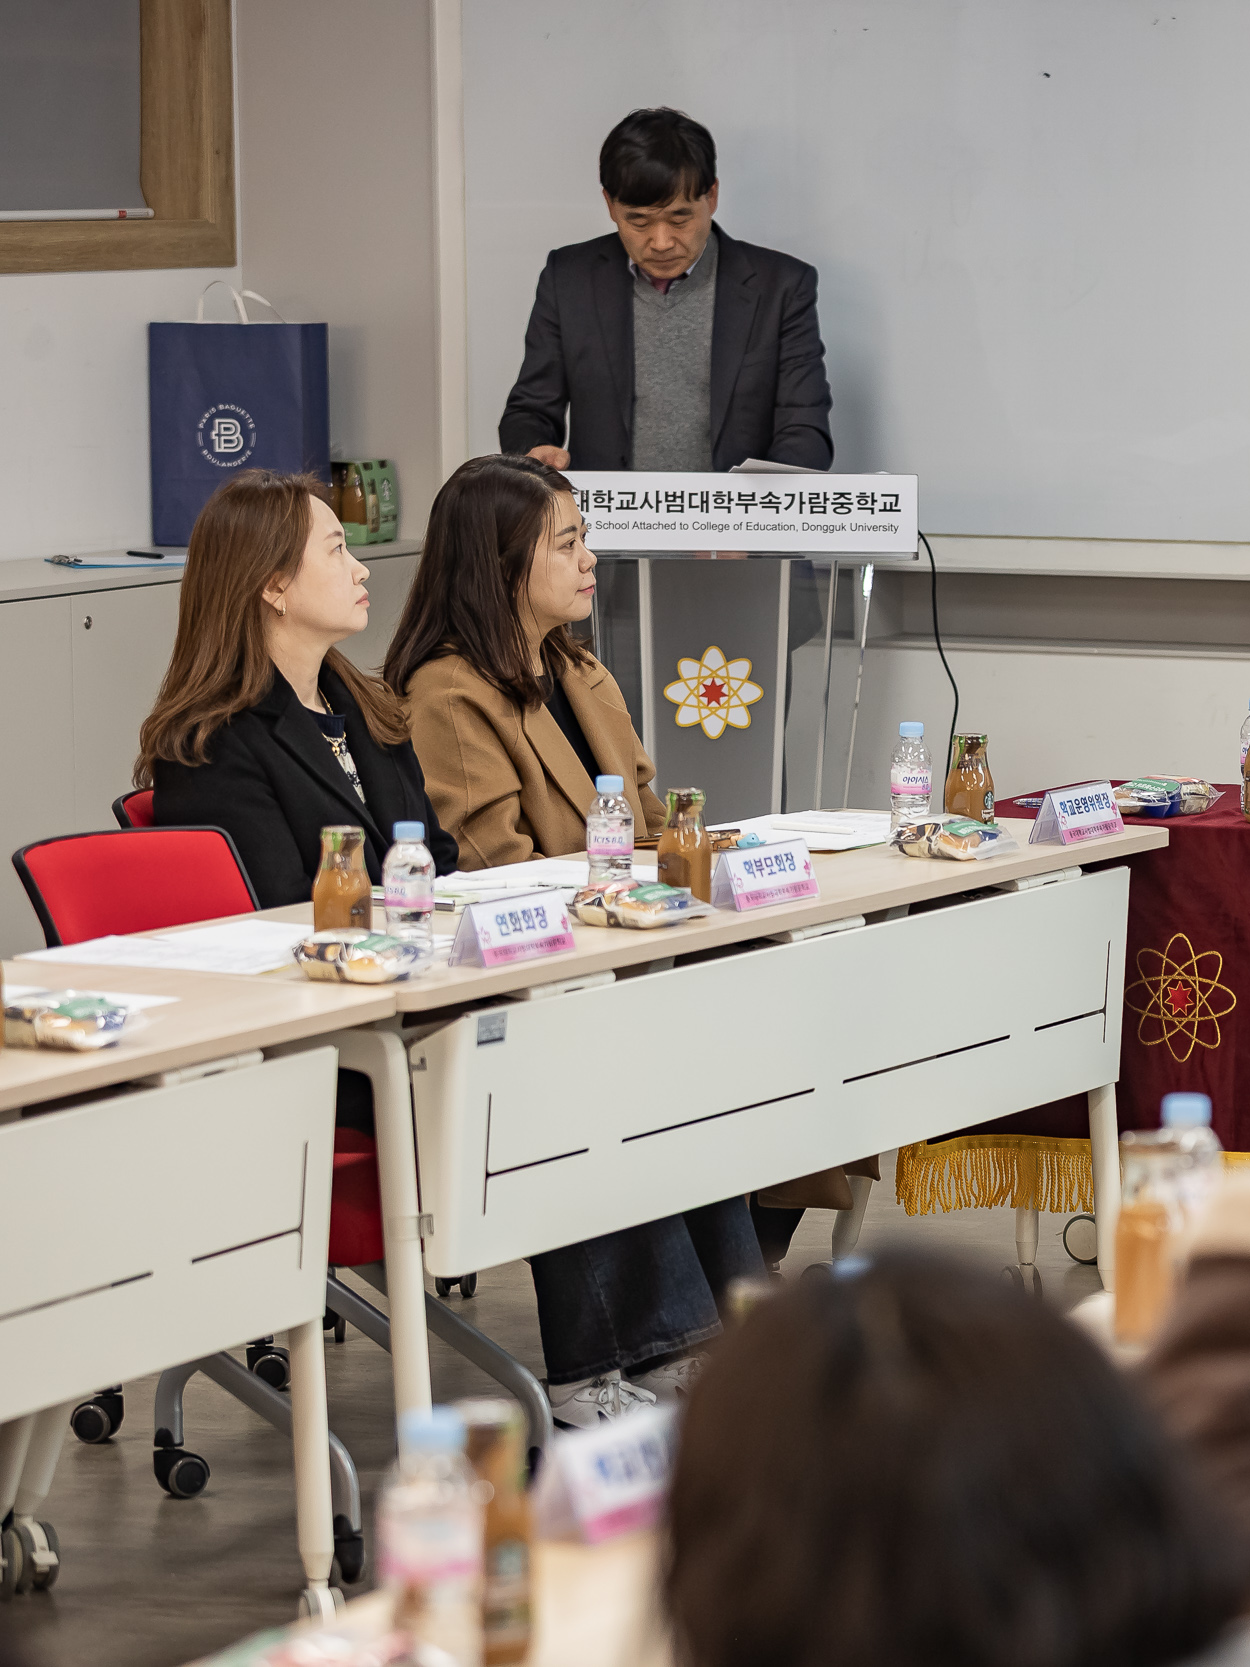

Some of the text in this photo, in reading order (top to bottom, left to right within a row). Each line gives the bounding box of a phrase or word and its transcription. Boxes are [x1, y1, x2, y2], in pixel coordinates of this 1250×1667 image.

[197, 404, 256, 430] PARIS BAGUETTE
[595, 520, 630, 531] School
[632, 521, 677, 531] Attached
[680, 522, 689, 531] to
[692, 521, 730, 534] College
[733, 522, 743, 532] of
[746, 522, 799, 533] Education,
[802, 523, 847, 535] Dongguk
[850, 523, 900, 535] University
[1059, 792, 1112, 817] 학교운영위원장
[742, 851, 797, 879] 학부모회장
[495, 905, 549, 937] 연화회장
